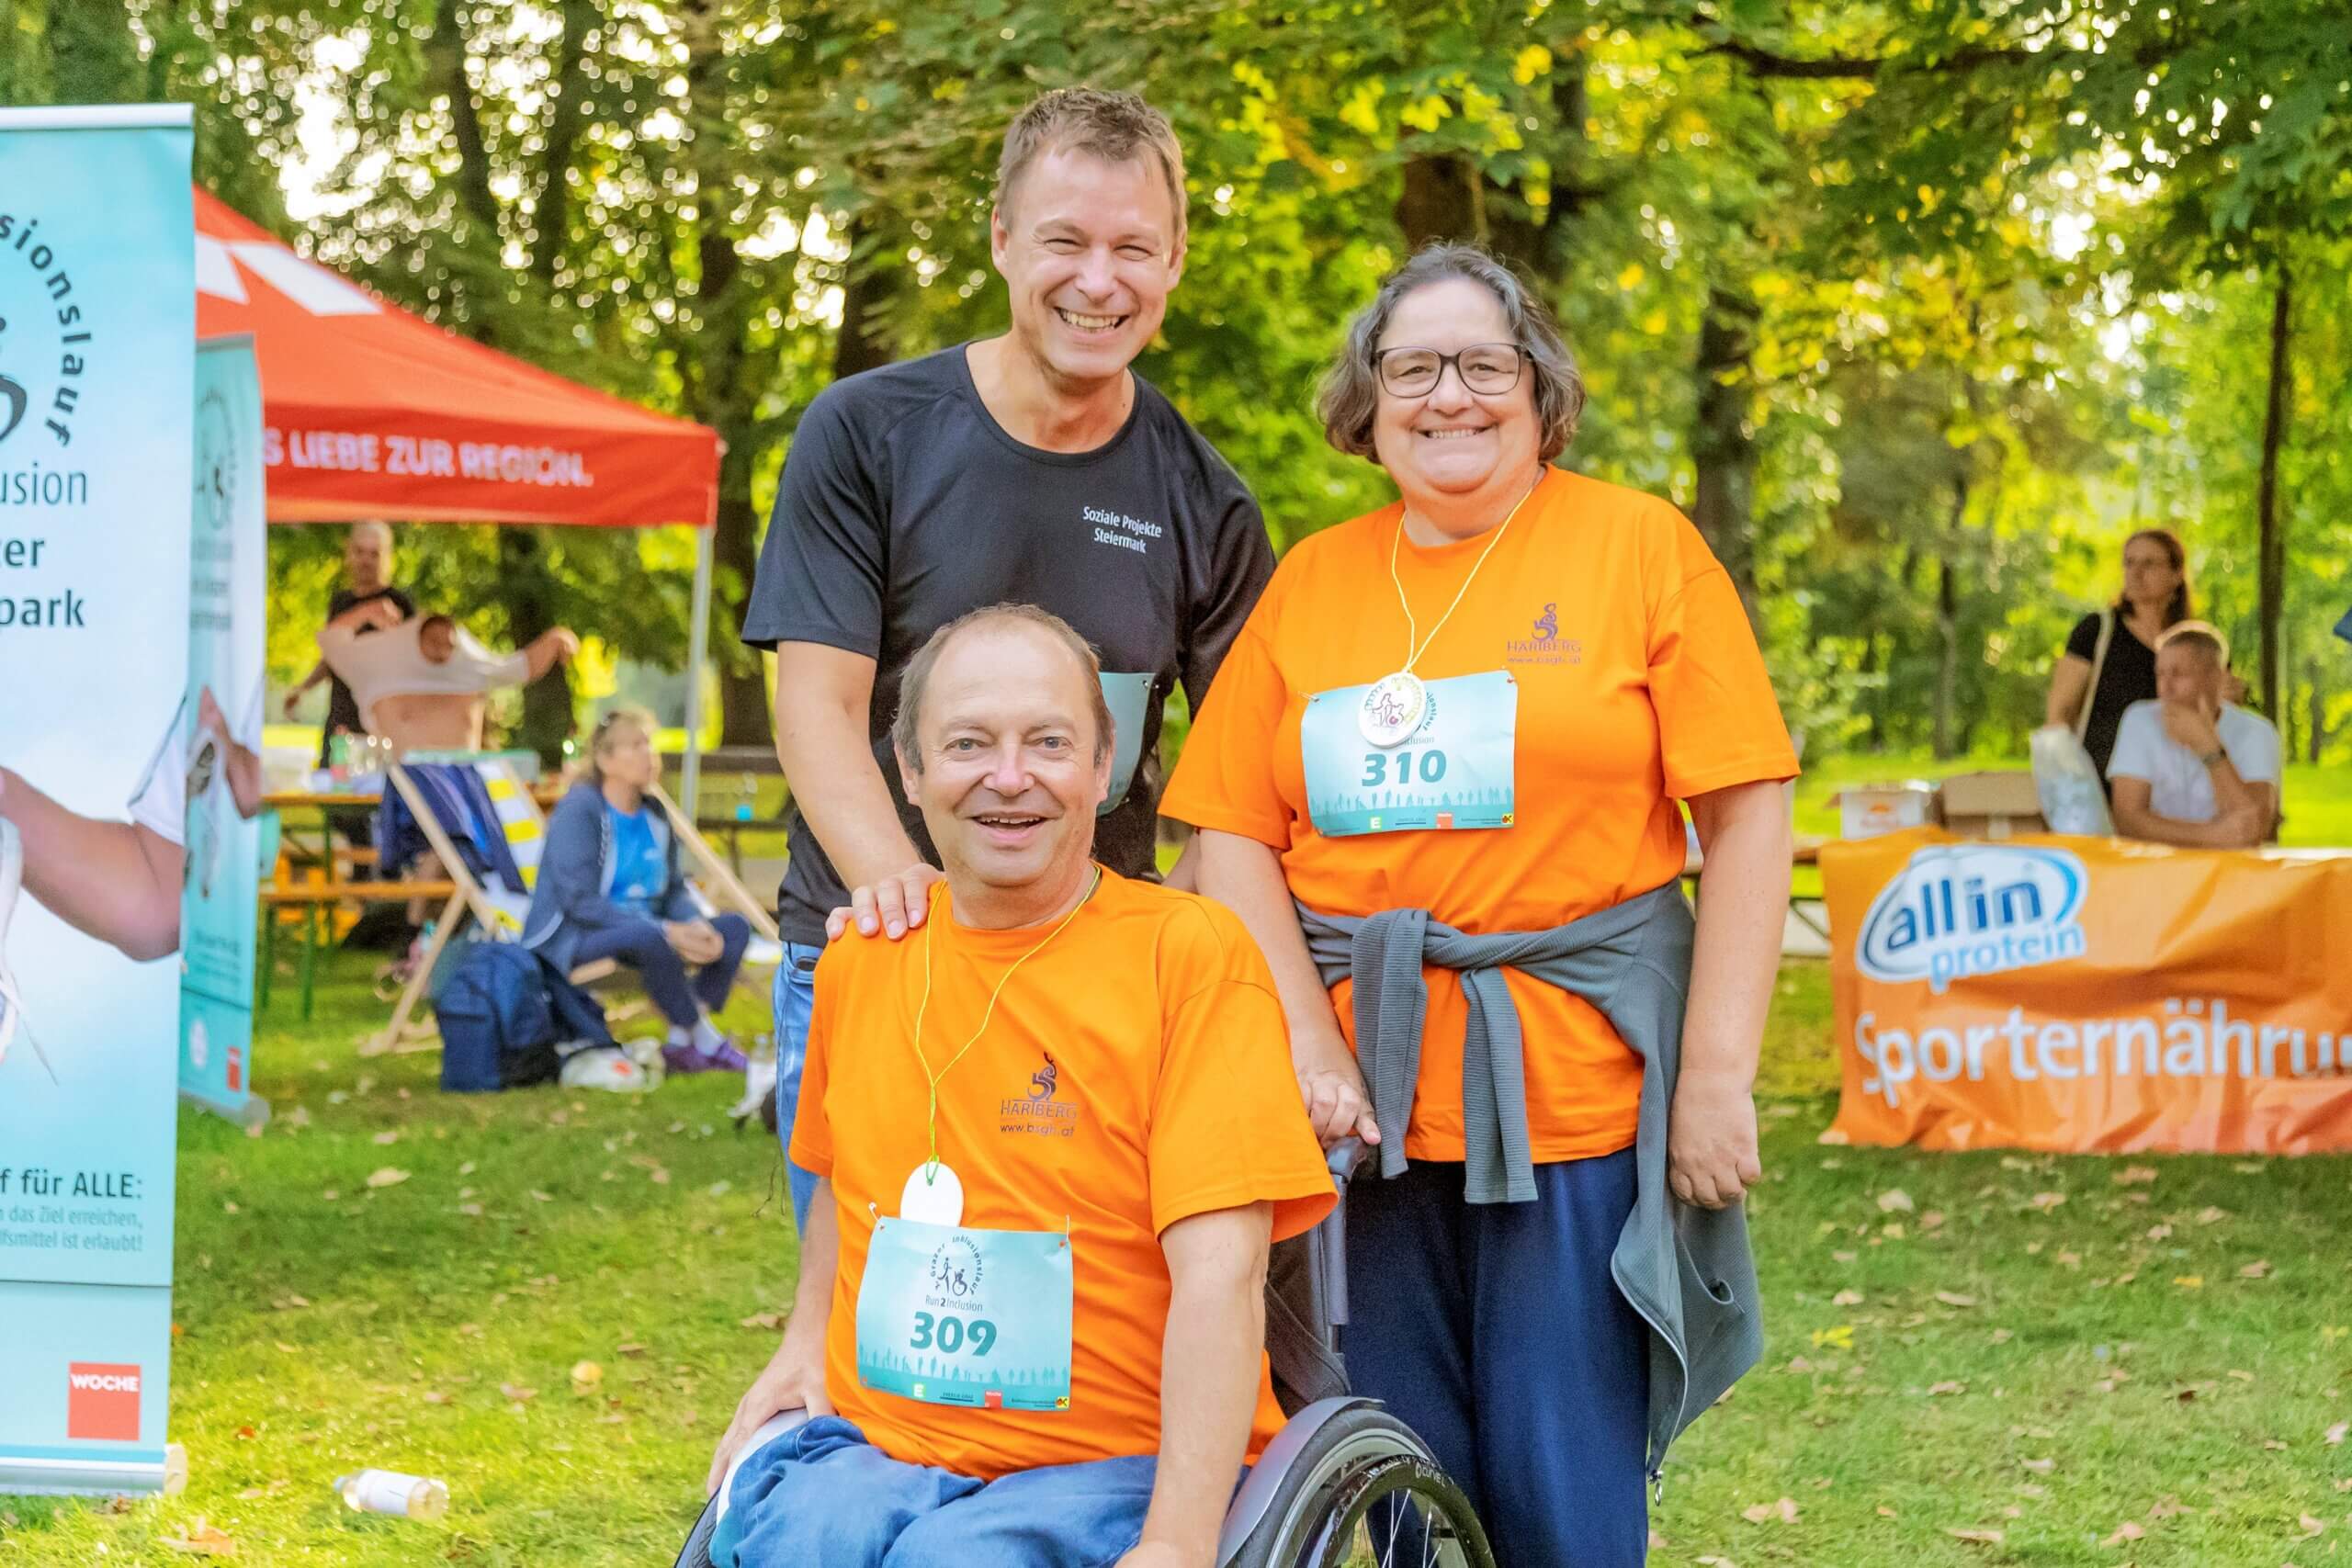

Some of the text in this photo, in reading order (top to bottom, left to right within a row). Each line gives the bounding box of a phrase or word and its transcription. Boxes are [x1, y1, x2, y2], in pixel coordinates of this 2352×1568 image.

[288, 430, 381, 472] LIEBE
[383, 435, 457, 478] ZUR
[1082, 506, 1162, 538] Soziale Projekte
[1093, 527, 1148, 554] Steiermark
[1361, 749, 1448, 787] 310
[1930, 921, 2082, 992] protein
[21, 1169, 63, 1195] für
[73, 1171, 143, 1199] ALLE:
[9, 1205, 35, 1223] das
[62, 1231, 79, 1250] ist
[910, 1312, 998, 1357] 309
[70, 1373, 140, 1393] WOCHE
